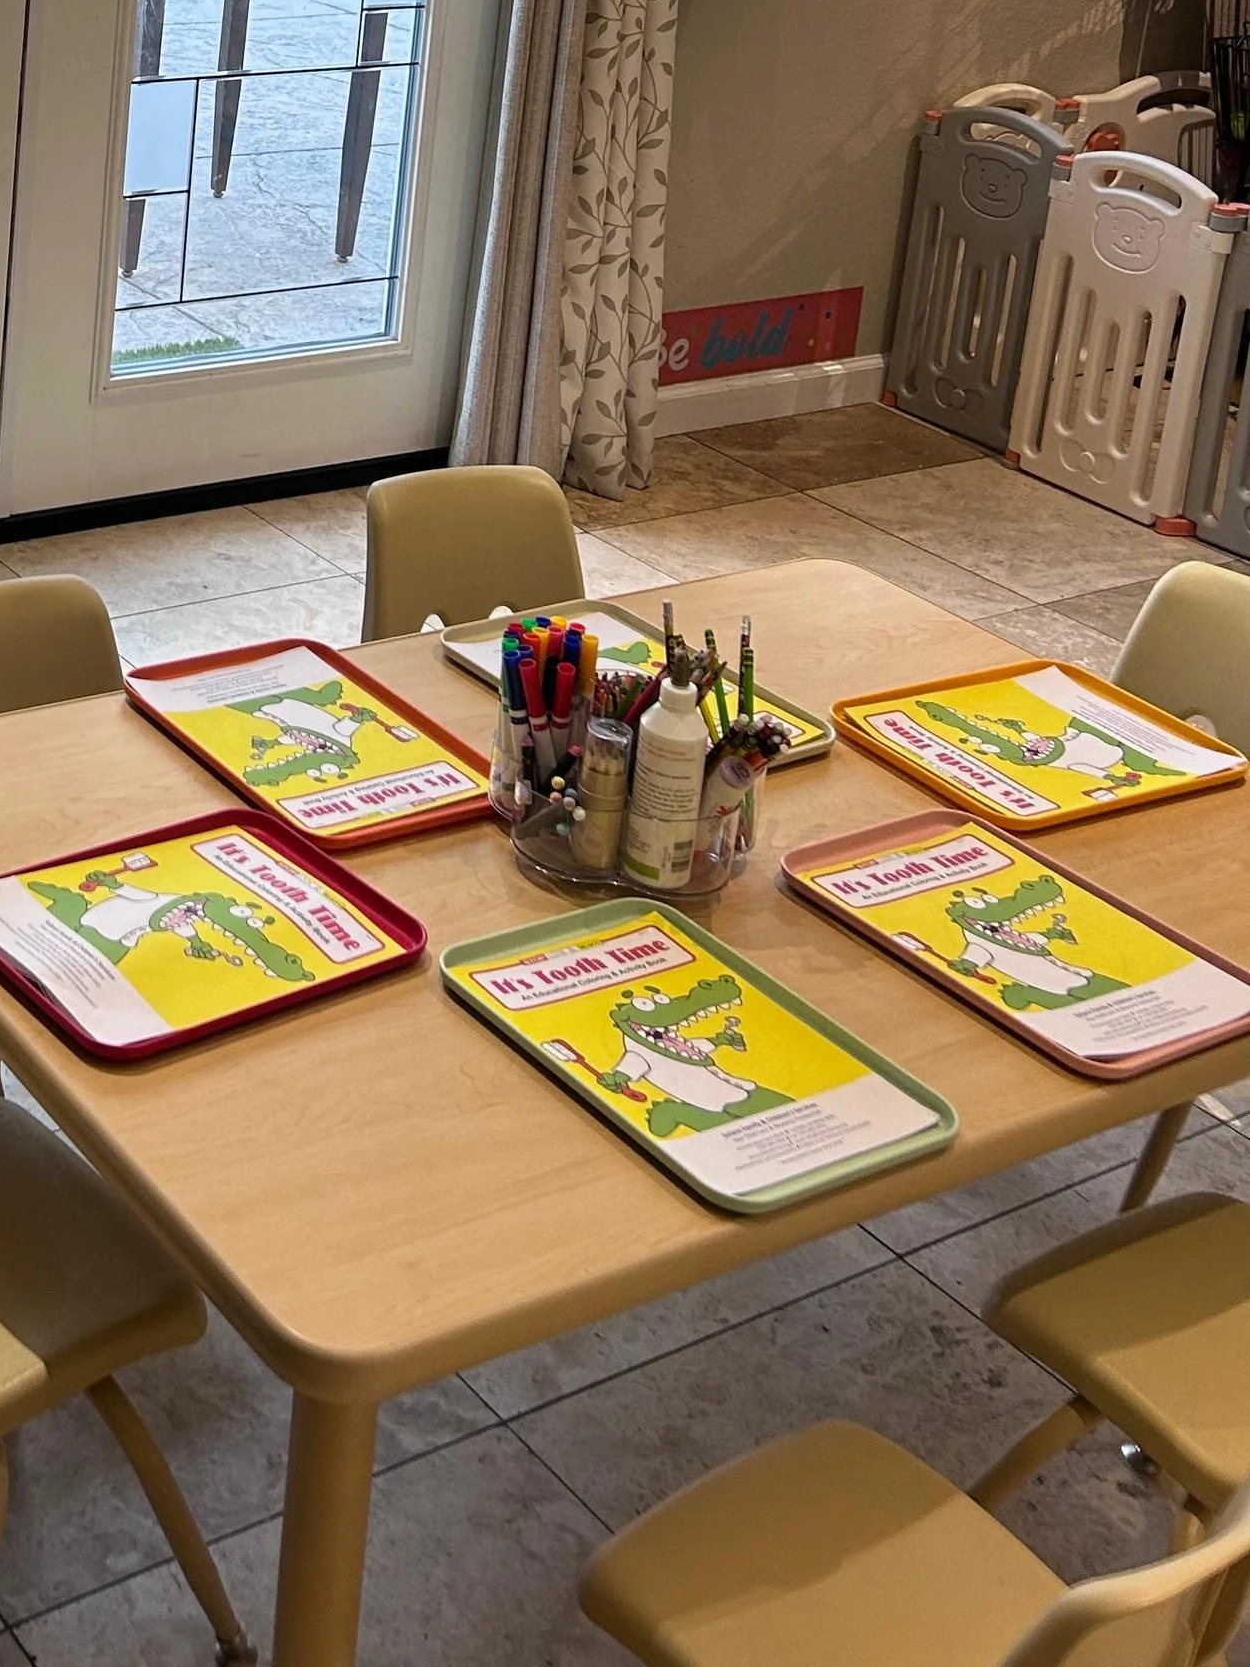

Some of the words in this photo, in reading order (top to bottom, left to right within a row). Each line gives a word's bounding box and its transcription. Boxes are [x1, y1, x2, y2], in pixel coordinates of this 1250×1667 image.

[700, 307, 793, 370] bold
[884, 719, 934, 752] Time
[423, 772, 461, 787] It's
[935, 751, 997, 789] Tooth
[297, 800, 358, 819] Time
[358, 782, 425, 805] Tooth
[831, 881, 871, 895] It's
[867, 860, 934, 885] Tooth
[929, 846, 988, 868] Time
[217, 841, 250, 863] It's
[250, 864, 309, 903] Tooth
[308, 904, 360, 951] Time
[490, 977, 534, 995] It's
[532, 956, 609, 985] Tooth
[605, 938, 671, 964] Time
